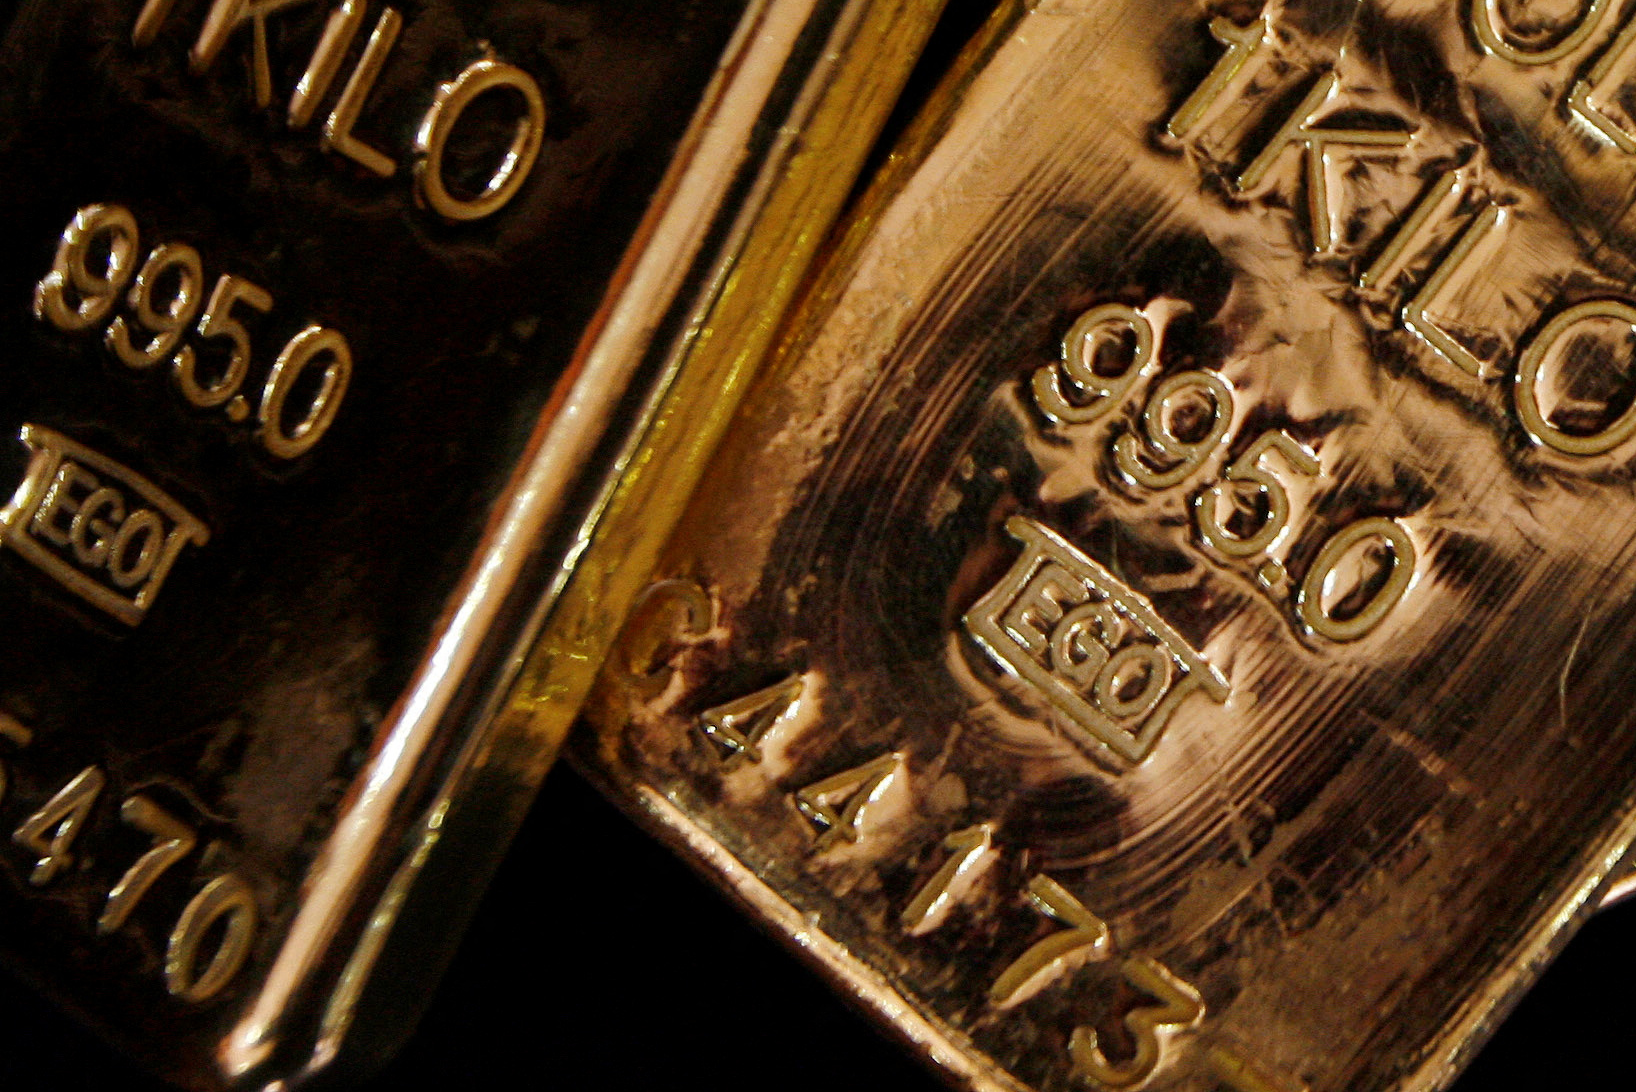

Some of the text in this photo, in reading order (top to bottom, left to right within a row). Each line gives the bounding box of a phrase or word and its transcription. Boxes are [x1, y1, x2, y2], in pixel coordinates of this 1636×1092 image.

[1165, 6, 1276, 143] 1
[34, 202, 352, 459] 995.0
[32, 459, 166, 588] EGO
[1030, 301, 1420, 642] 995.0
[1002, 561, 1172, 720] EGO
